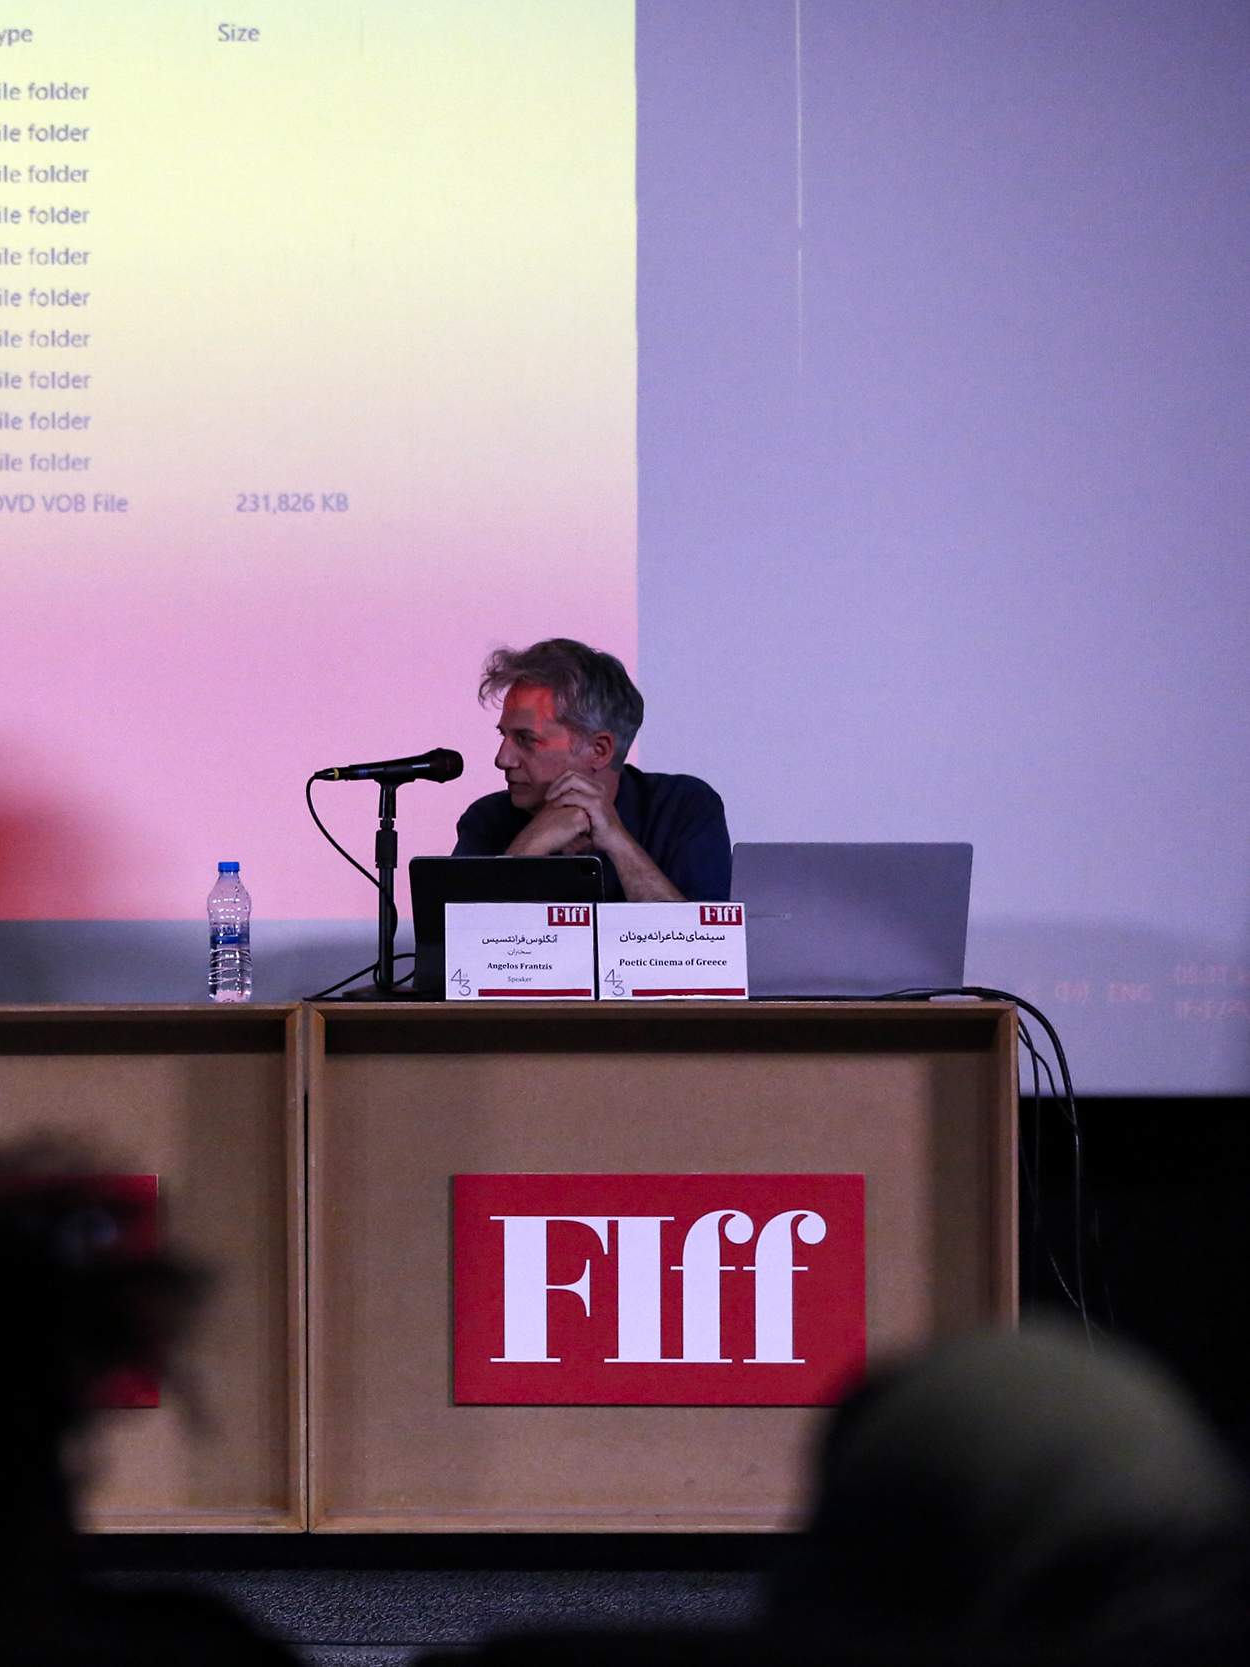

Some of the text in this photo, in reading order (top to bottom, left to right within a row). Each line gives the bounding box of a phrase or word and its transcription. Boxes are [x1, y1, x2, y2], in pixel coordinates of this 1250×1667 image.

[217, 22, 261, 43] Size
[26, 81, 90, 101] folder
[26, 122, 90, 143] folder
[27, 164, 90, 184] folder
[27, 205, 91, 226] folder
[28, 246, 91, 266] folder
[28, 287, 91, 308] folder
[28, 328, 91, 349] folder
[28, 370, 92, 390] folder
[28, 411, 92, 431] folder
[28, 452, 92, 472] folder
[40, 492, 87, 514] VOB
[92, 492, 129, 514] File
[235, 491, 350, 515] 231,826 KB
[481, 934, 558, 945] آنگلوس فرانتسیس
[619, 930, 726, 943] سینمای شاعرانه یونان
[487, 962, 553, 970] Angelos Frantzis
[619, 958, 727, 966] Poetic Cinema of Greece
[489, 1209, 827, 1364] FIff
